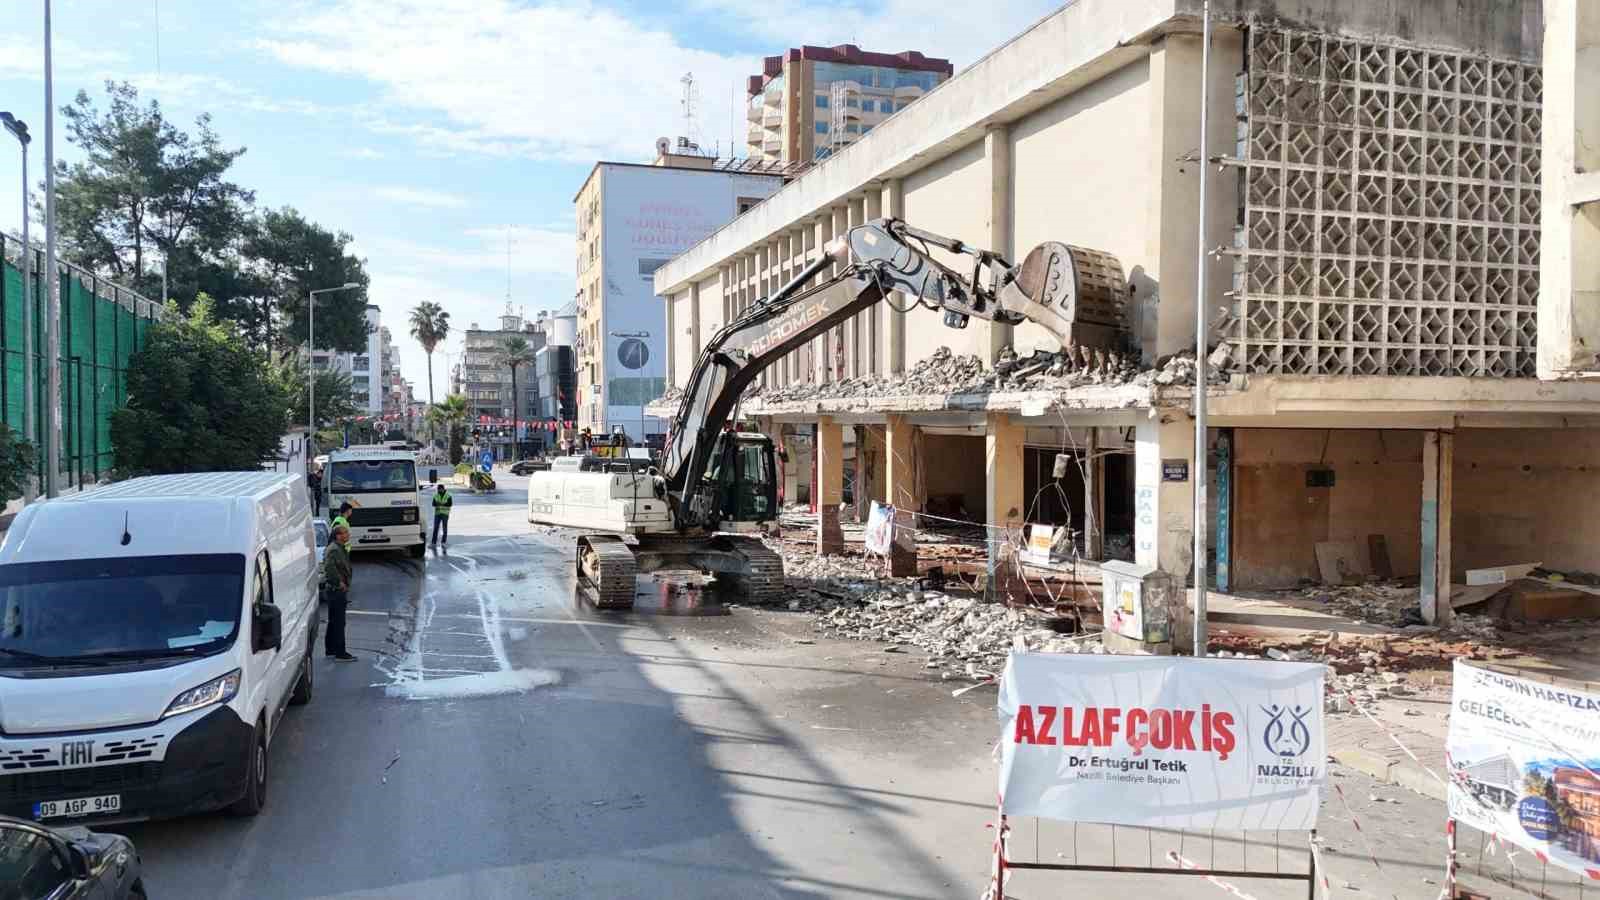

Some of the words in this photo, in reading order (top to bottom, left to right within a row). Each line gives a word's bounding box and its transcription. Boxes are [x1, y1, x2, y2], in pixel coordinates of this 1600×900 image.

[1014, 704, 1057, 746] AZ
[1063, 705, 1120, 749] LAF
[1126, 706, 1196, 756] ÇOK
[1201, 703, 1236, 761] İŞ
[62, 740, 95, 766] FIAT
[1069, 756, 1087, 767] Dr.
[1091, 756, 1148, 772] Ertuğrul
[1152, 759, 1187, 772] Tetik
[1147, 775, 1181, 785] Başkanı
[41, 802, 57, 817] 09
[64, 799, 88, 815] AGP
[95, 796, 118, 811] 940
